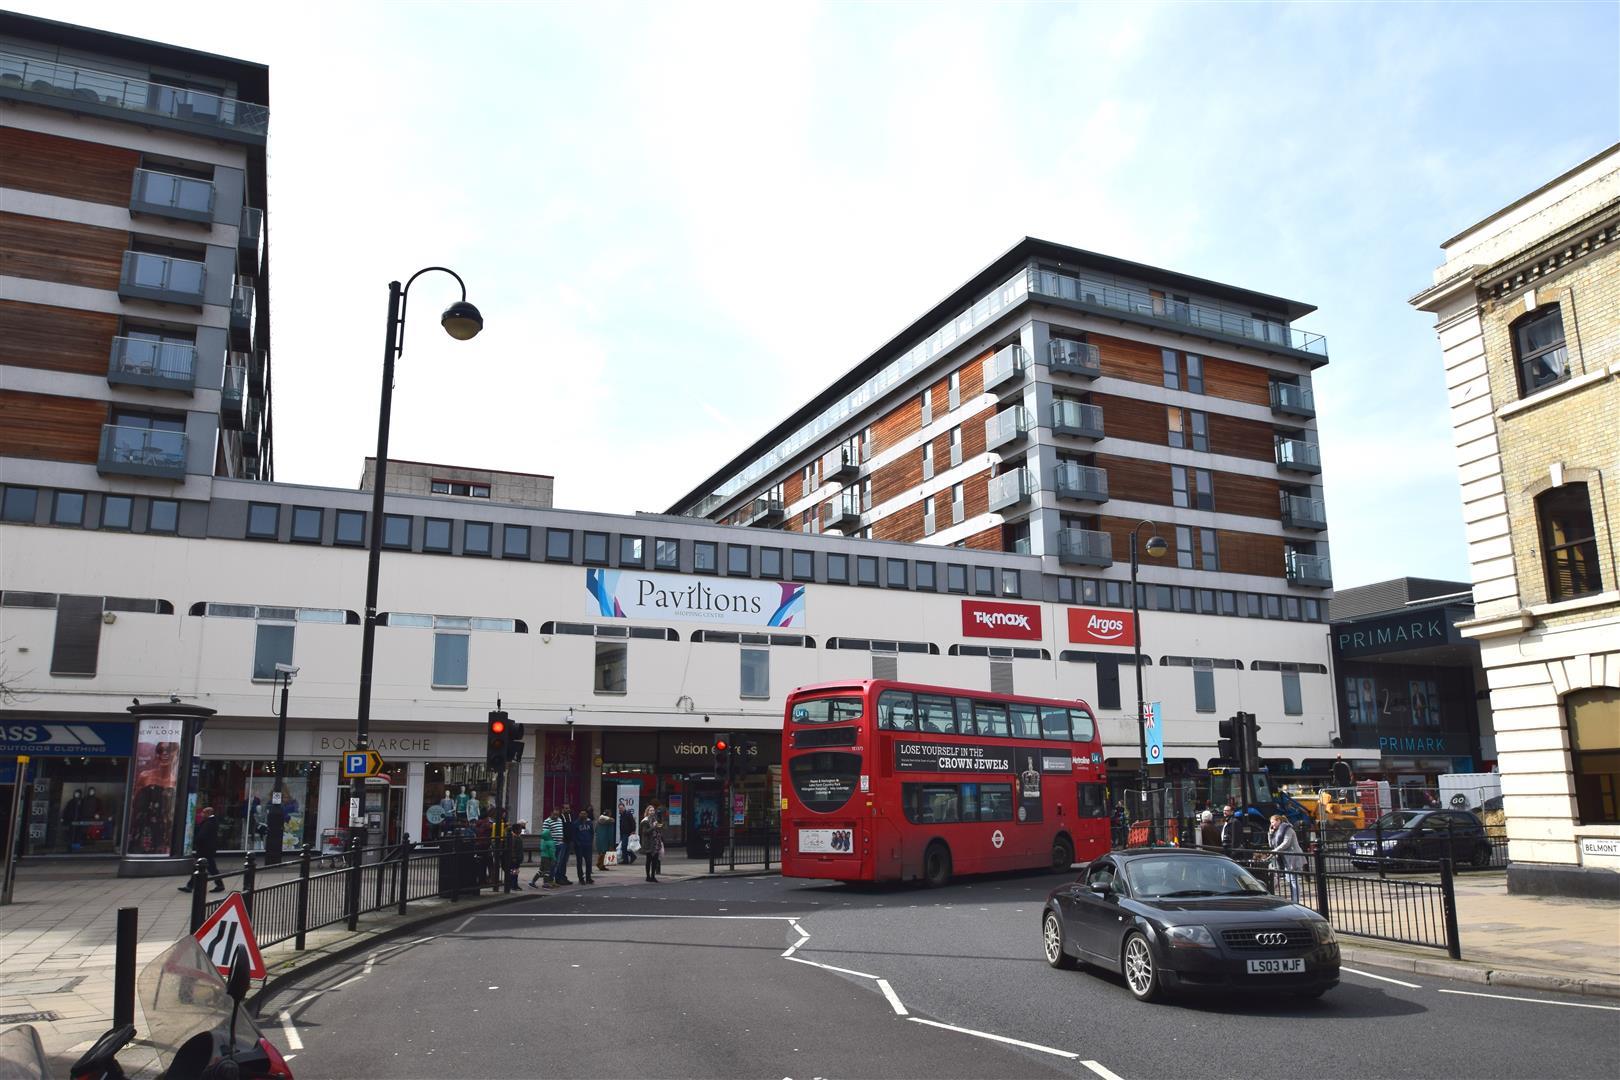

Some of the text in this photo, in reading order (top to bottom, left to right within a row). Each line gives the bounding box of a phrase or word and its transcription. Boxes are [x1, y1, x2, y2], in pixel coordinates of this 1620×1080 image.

[636, 579, 762, 614] Pavilions
[1087, 614, 1123, 633] Argos
[1339, 620, 1442, 650] PRIMARK
[673, 742, 709, 755] vision
[900, 744, 984, 758] LOSE YOURSELF IN THE
[1379, 737, 1446, 751] PRIMARK
[351, 756, 363, 772] P
[938, 757, 973, 769] CROWN
[974, 759, 1009, 771] JEWELS
[1586, 844, 1617, 852] BELMONT
[1251, 959, 1302, 972] LS03 WJF
